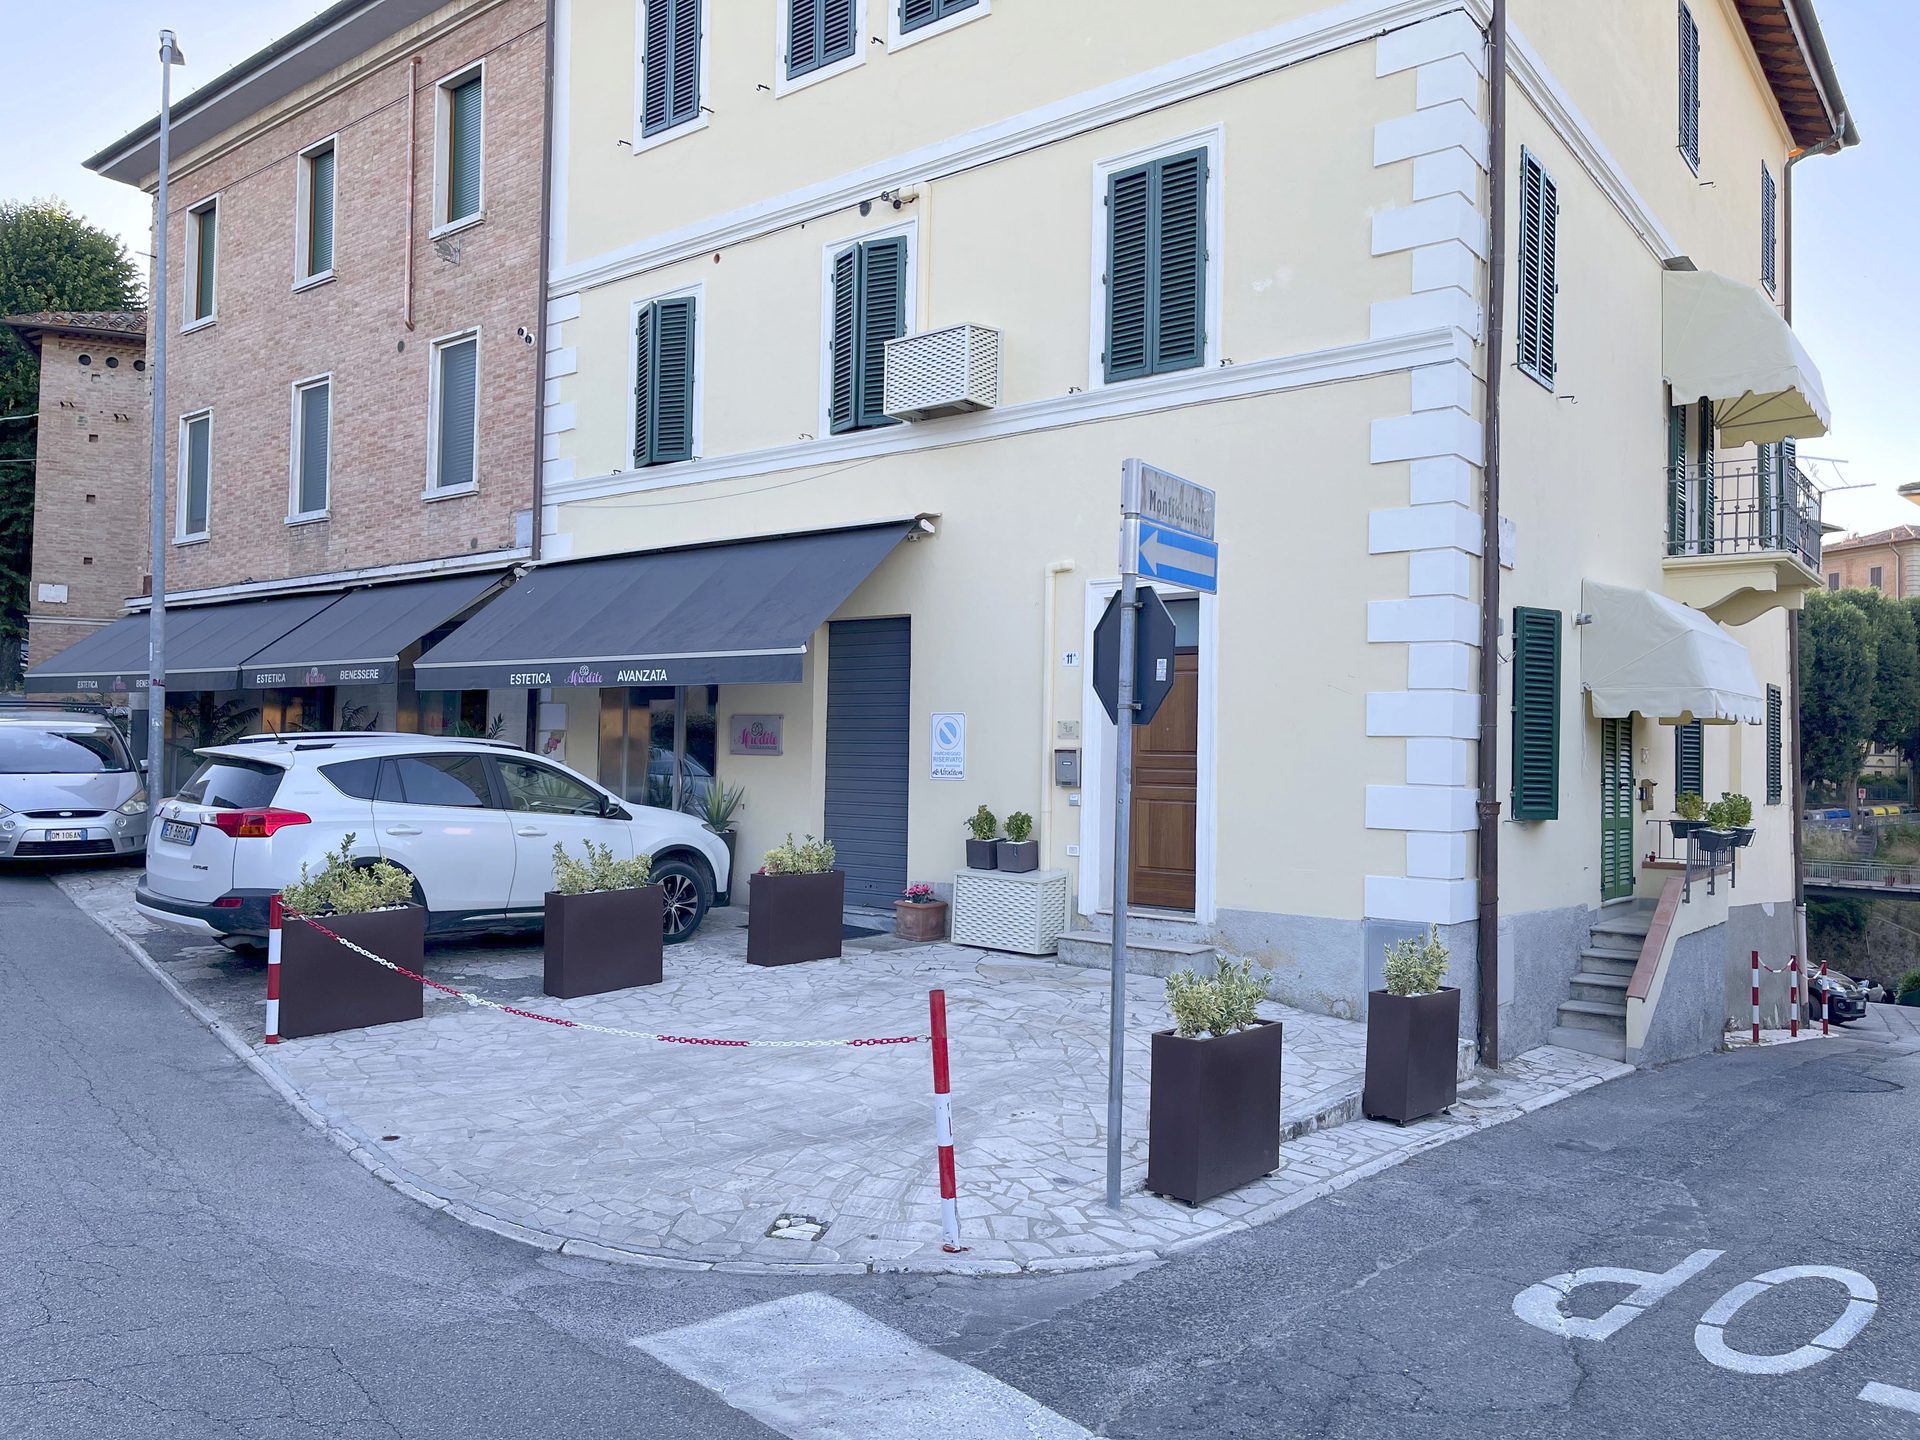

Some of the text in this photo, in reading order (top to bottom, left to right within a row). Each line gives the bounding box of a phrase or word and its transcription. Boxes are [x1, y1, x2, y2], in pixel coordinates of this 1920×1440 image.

[77, 680, 98, 689] ESTETICA
[136, 679, 150, 688] BENES
[256, 673, 286, 684] ESTETICA
[340, 668, 379, 680] BENESSERE
[510, 672, 551, 685] ESTETICA
[617, 669, 667, 682] AVANZATA
[1512, 1248, 1920, 1414] OP
